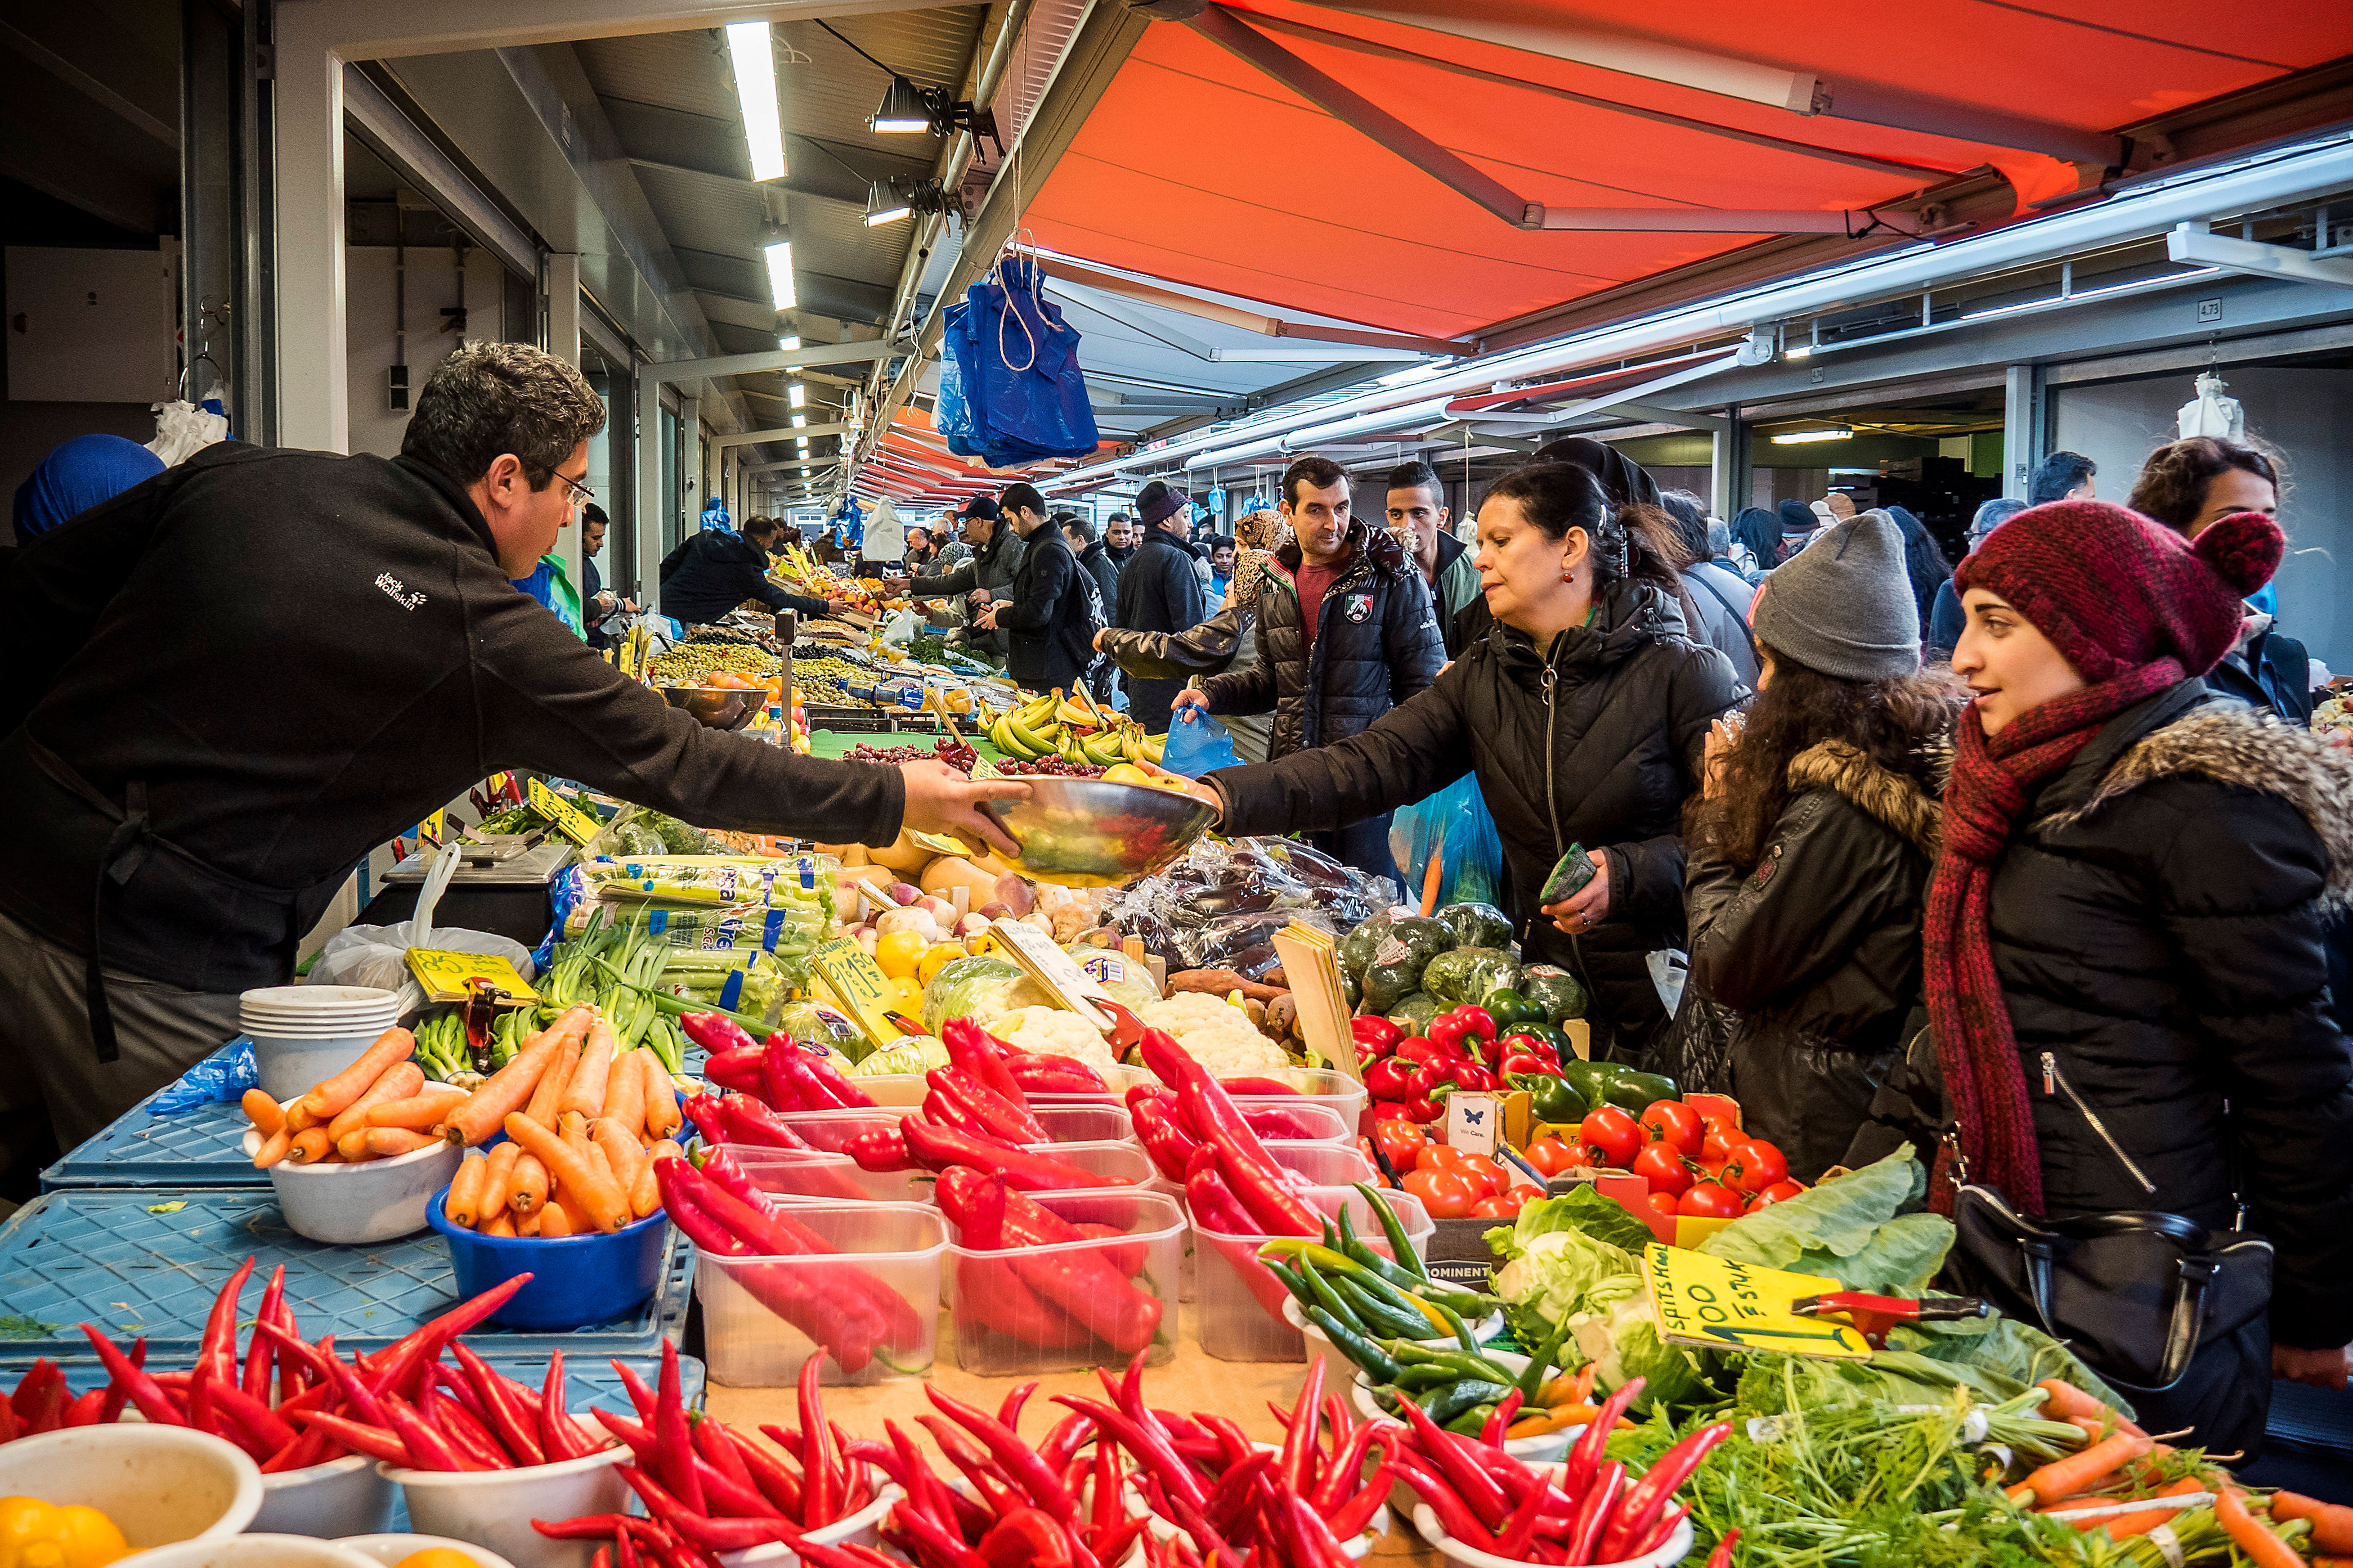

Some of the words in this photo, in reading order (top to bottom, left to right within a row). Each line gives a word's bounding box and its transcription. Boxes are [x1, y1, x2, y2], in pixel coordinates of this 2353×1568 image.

[2200, 303, 2218, 315] 4.73
[380, 572, 404, 591] Jack
[374, 576, 415, 611] Wolfskin
[416, 952, 464, 974] 85
